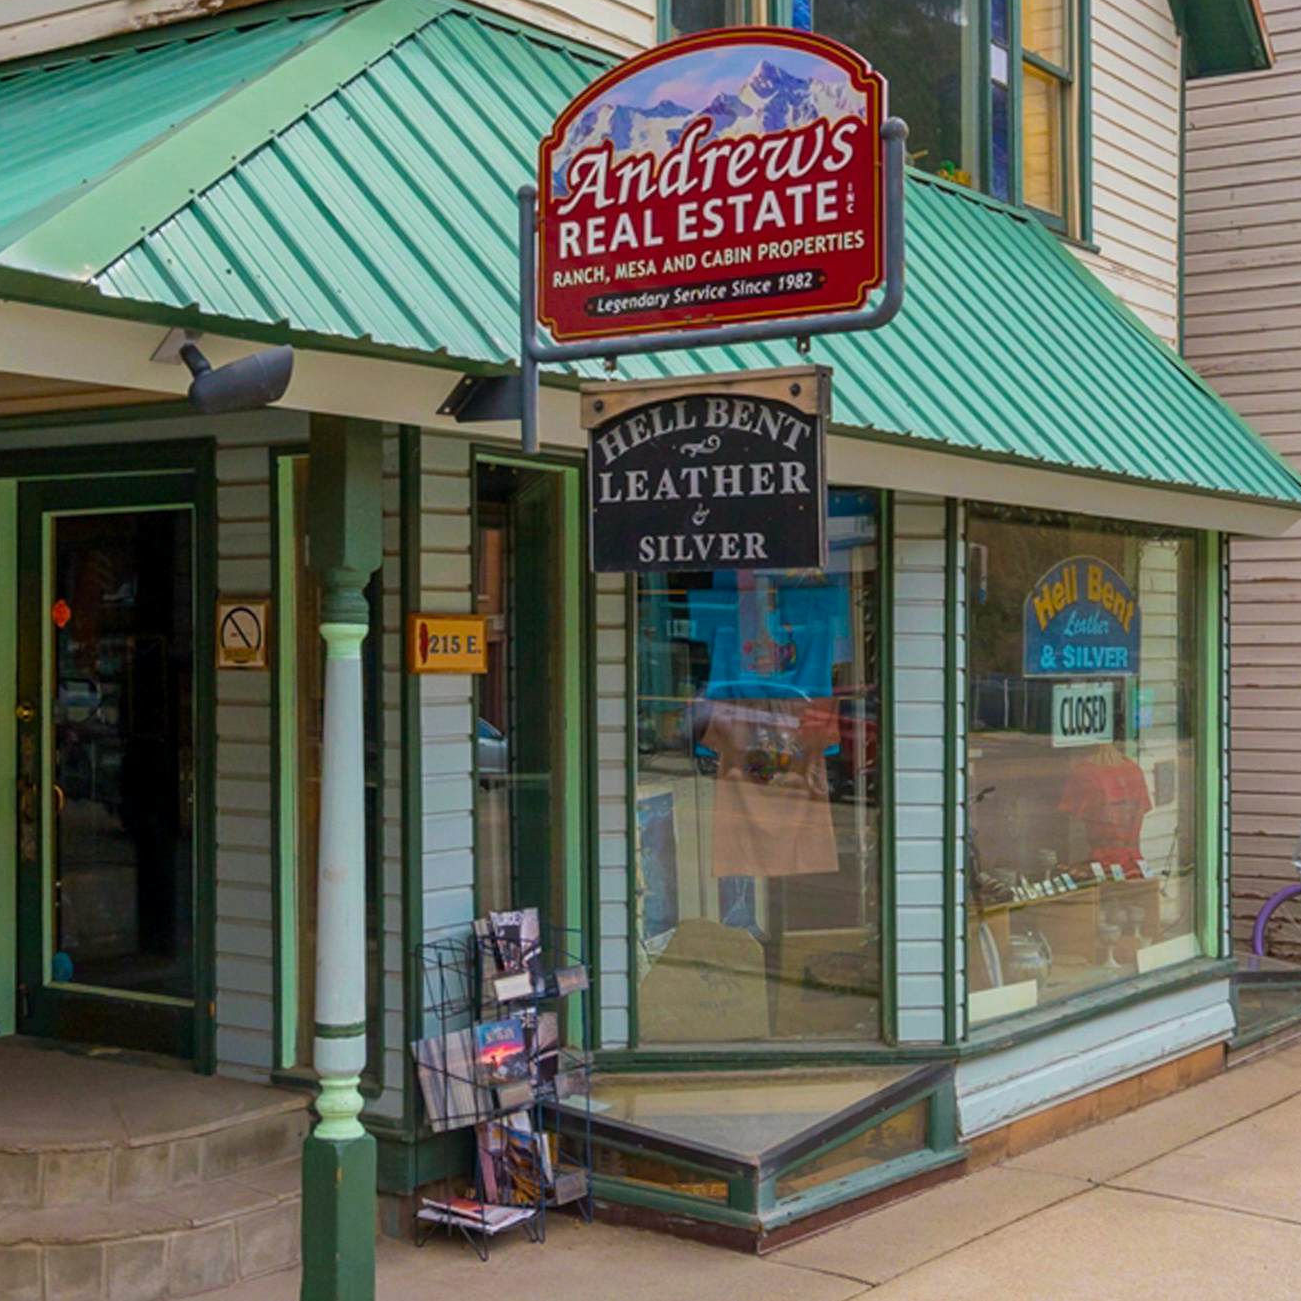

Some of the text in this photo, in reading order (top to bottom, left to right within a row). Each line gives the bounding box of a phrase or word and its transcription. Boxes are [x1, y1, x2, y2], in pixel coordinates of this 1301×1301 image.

[557, 122, 858, 216] Andrews
[559, 180, 840, 259] REAL ESTATE
[552, 230, 865, 290] RANCH, MESA AND CABIN PROPERTIES
[597, 271, 814, 314] Legendary Service Since 1982
[596, 397, 812, 466] HELL BENT
[598, 461, 812, 503] LEATHER
[691, 502, 711, 526] &
[638, 531, 768, 563] SILVER
[1033, 563, 1135, 637] Hell Bent
[429, 634, 482, 655] 215 E.
[1039, 644, 1129, 669] & SILVER
[1060, 694, 1107, 737] CLOSED
